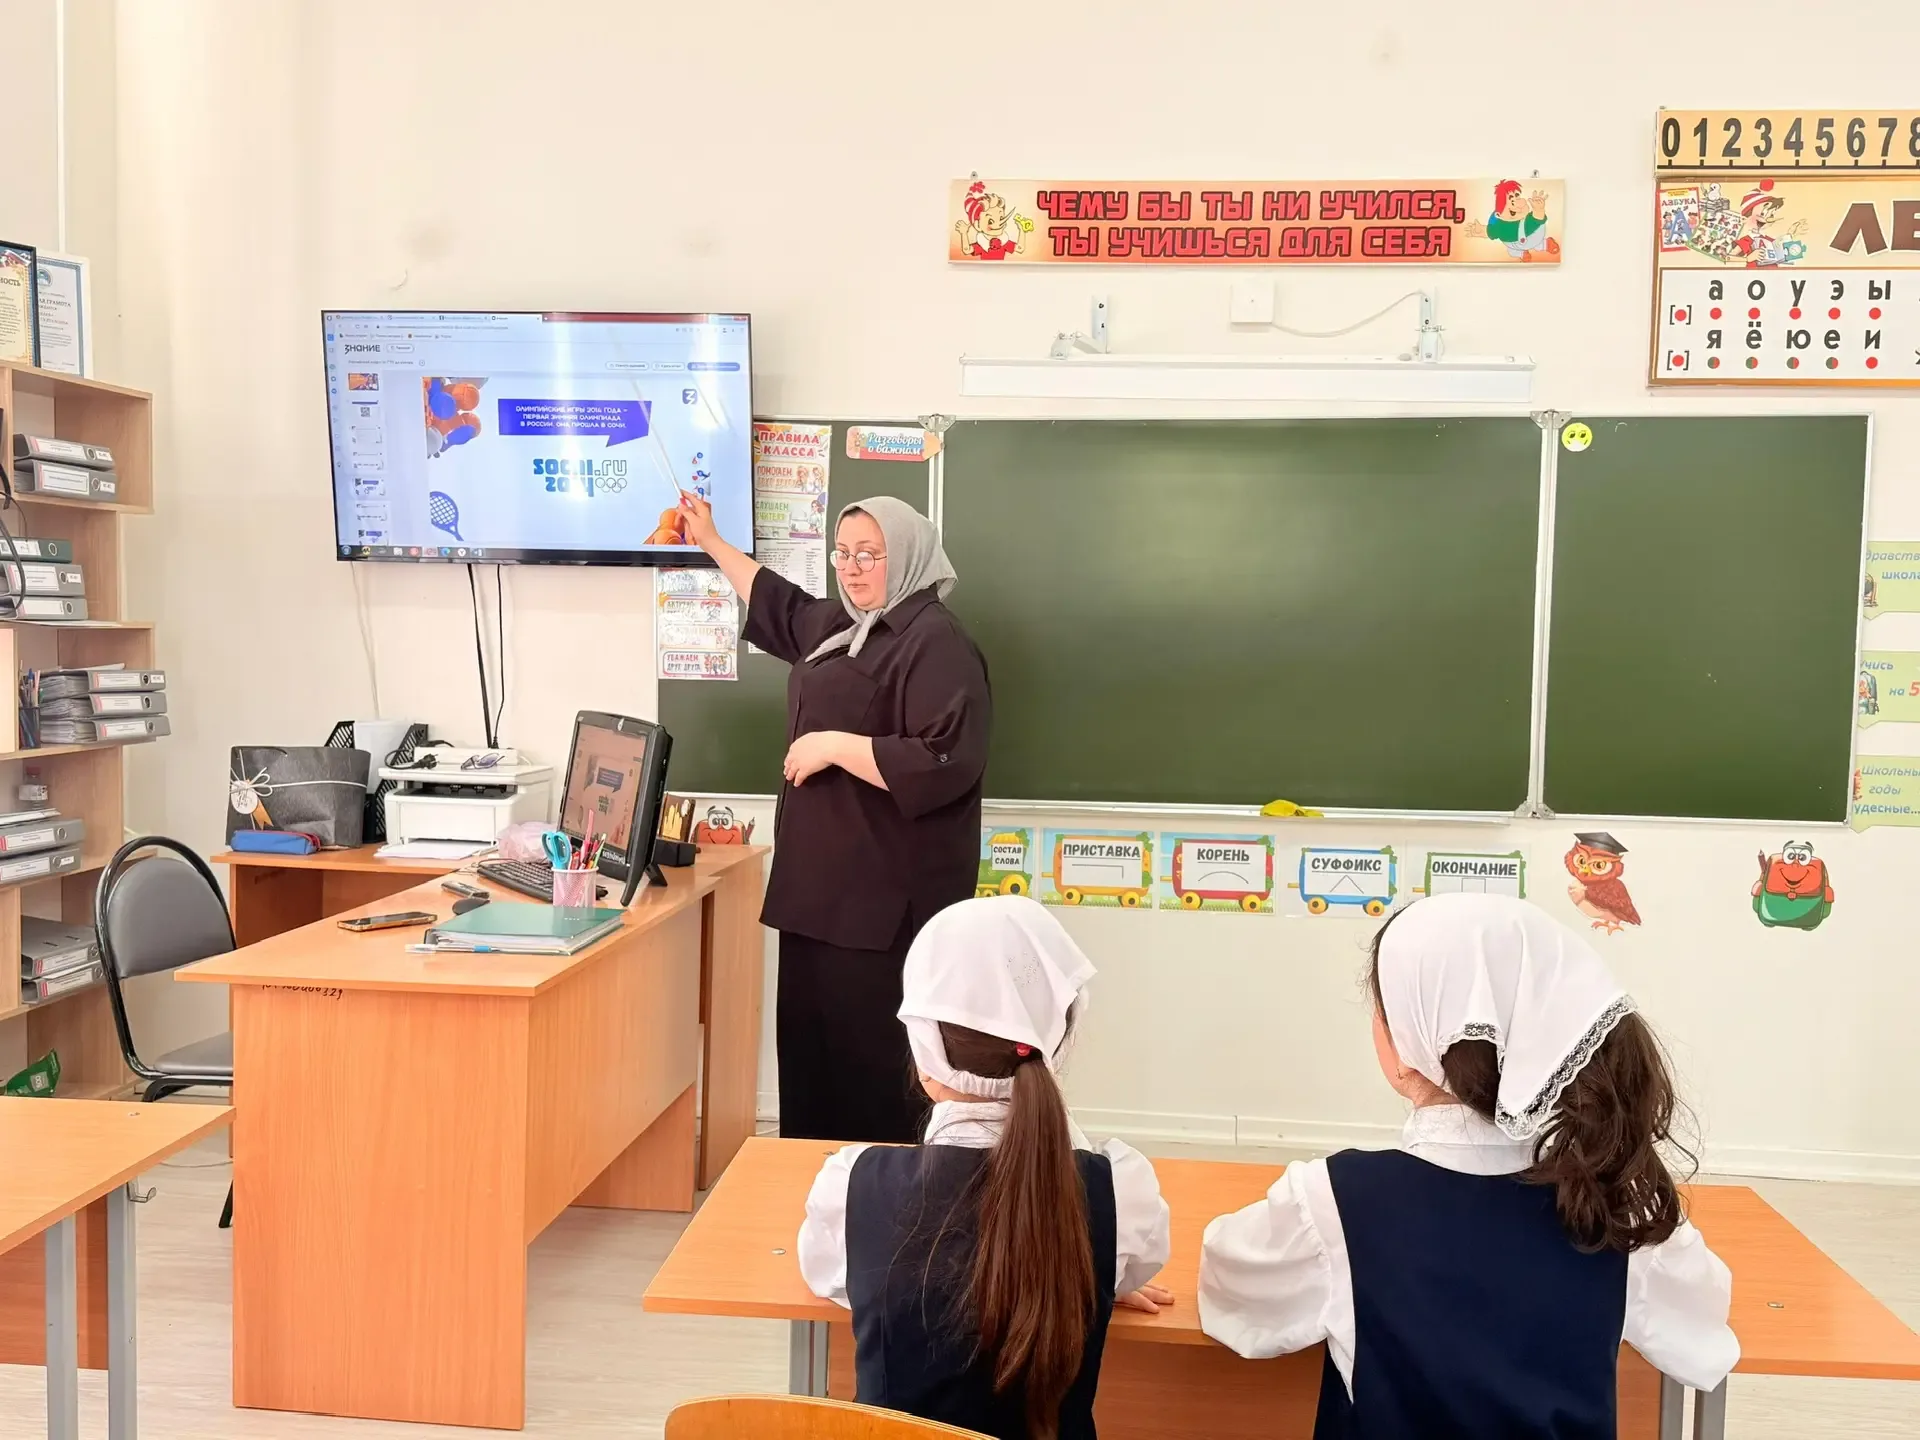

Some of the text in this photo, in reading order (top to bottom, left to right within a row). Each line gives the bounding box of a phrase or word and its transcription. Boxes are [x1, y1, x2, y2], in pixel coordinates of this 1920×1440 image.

[1662, 118, 1680, 157] 0
[1694, 118, 1707, 157] 1
[1722, 118, 1742, 157] 2
[1753, 118, 1772, 157] 3
[1784, 118, 1803, 157] 4
[1815, 118, 1834, 157] 5
[1847, 118, 1865, 157] 6
[1878, 118, 1897, 157] 7
[1037, 190, 1465, 223] ЧЕМУ БЫ ТЫ НИ УЧИЛСЯ,
[1662, 198, 1696, 206] АЗБУКА
[1049, 226, 1451, 257] ТЫ УЧИШЬСЯ ДЛЯ СЕБЯ
[1708, 280, 1891, 307] а о у э ы
[1707, 321, 1880, 349] я ё ю е и
[516, 405, 565, 413] ОЛИМПИЙСКИЕ
[760, 432, 819, 444] ПРАВИЛА
[868, 432, 923, 447] Разговоры
[763, 445, 815, 457] КЛАССА
[545, 477, 594, 497] 204
[1889, 681, 1920, 697] на 5
[1869, 784, 1901, 795] годы
[993, 846, 1022, 854] СОСТАВ
[1063, 844, 1140, 858] ПРИСТАВКА
[1197, 848, 1250, 861] КОРЕНЬ
[995, 857, 1020, 865] СЛОВА
[1311, 857, 1381, 871] СУФФИКС
[1432, 861, 1518, 876] ОКОНЧАНИЕ
